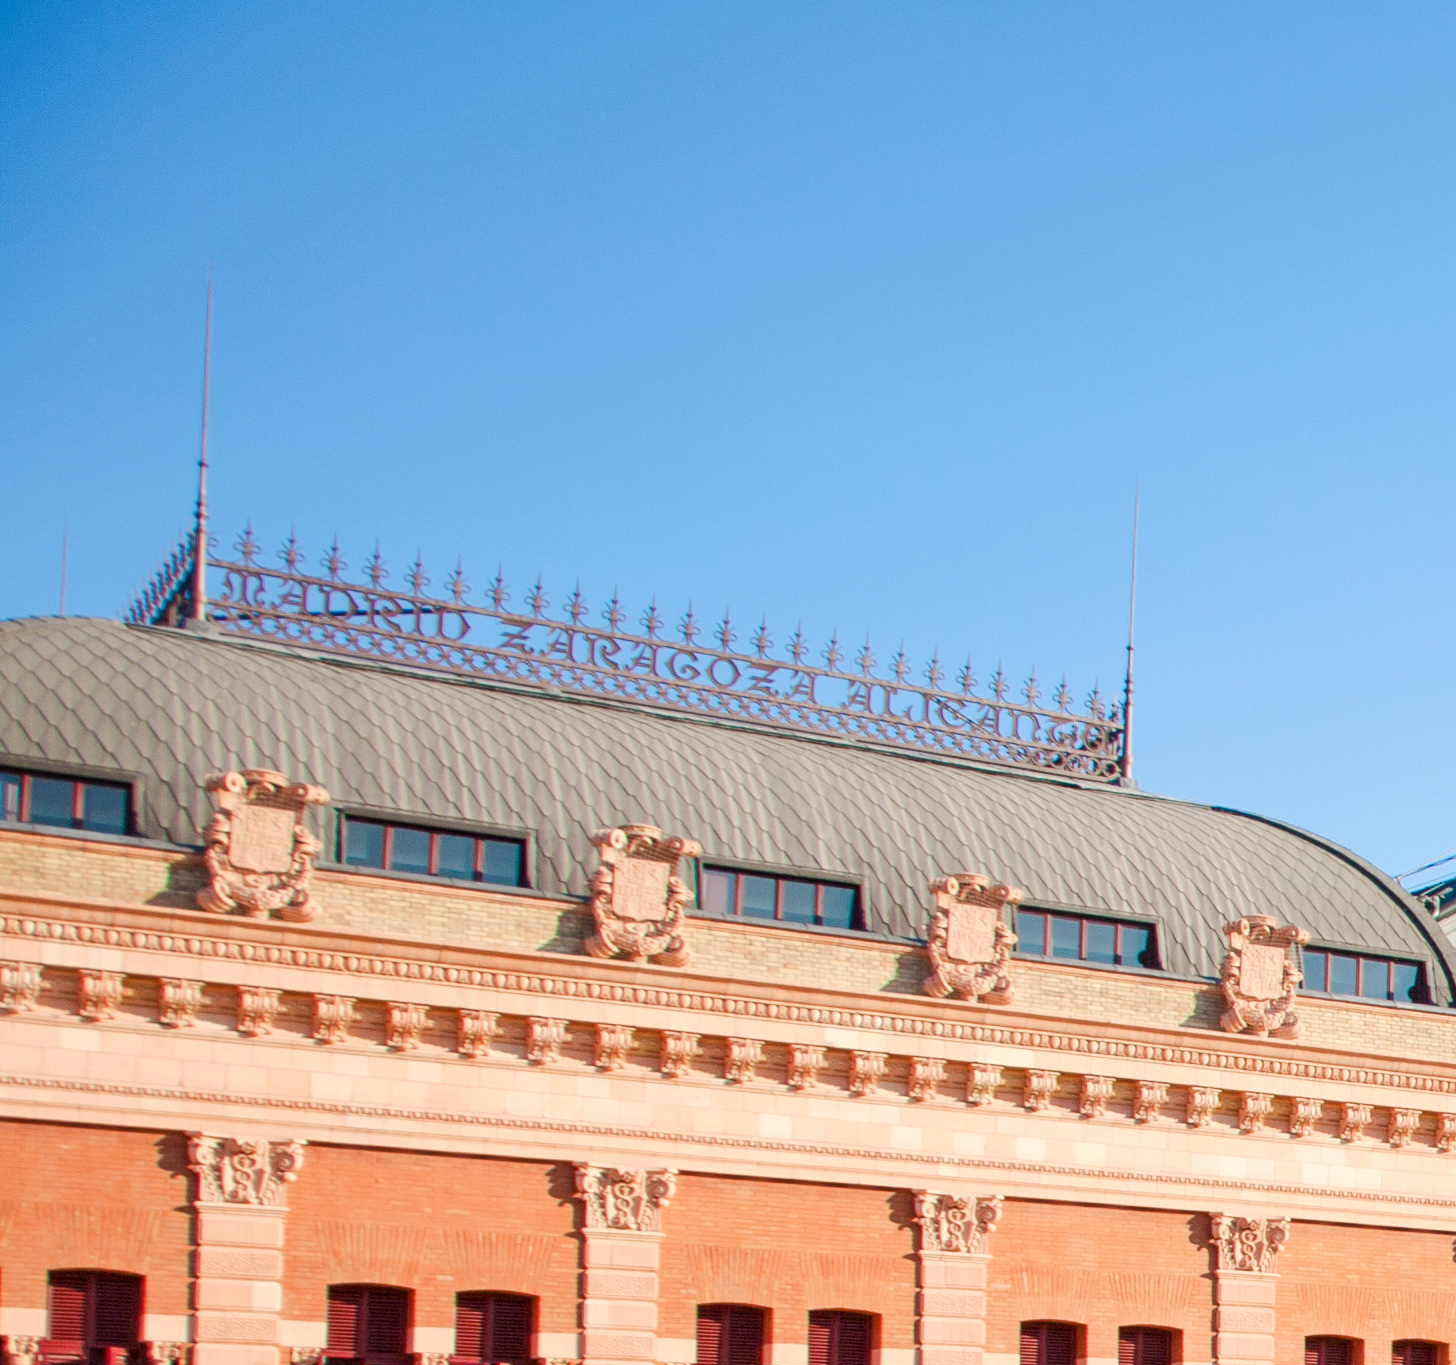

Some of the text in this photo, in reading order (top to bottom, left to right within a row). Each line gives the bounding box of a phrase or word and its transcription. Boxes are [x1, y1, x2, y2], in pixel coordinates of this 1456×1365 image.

[220, 568, 1108, 754] MADRID ZARAGOZA ALICANTE
